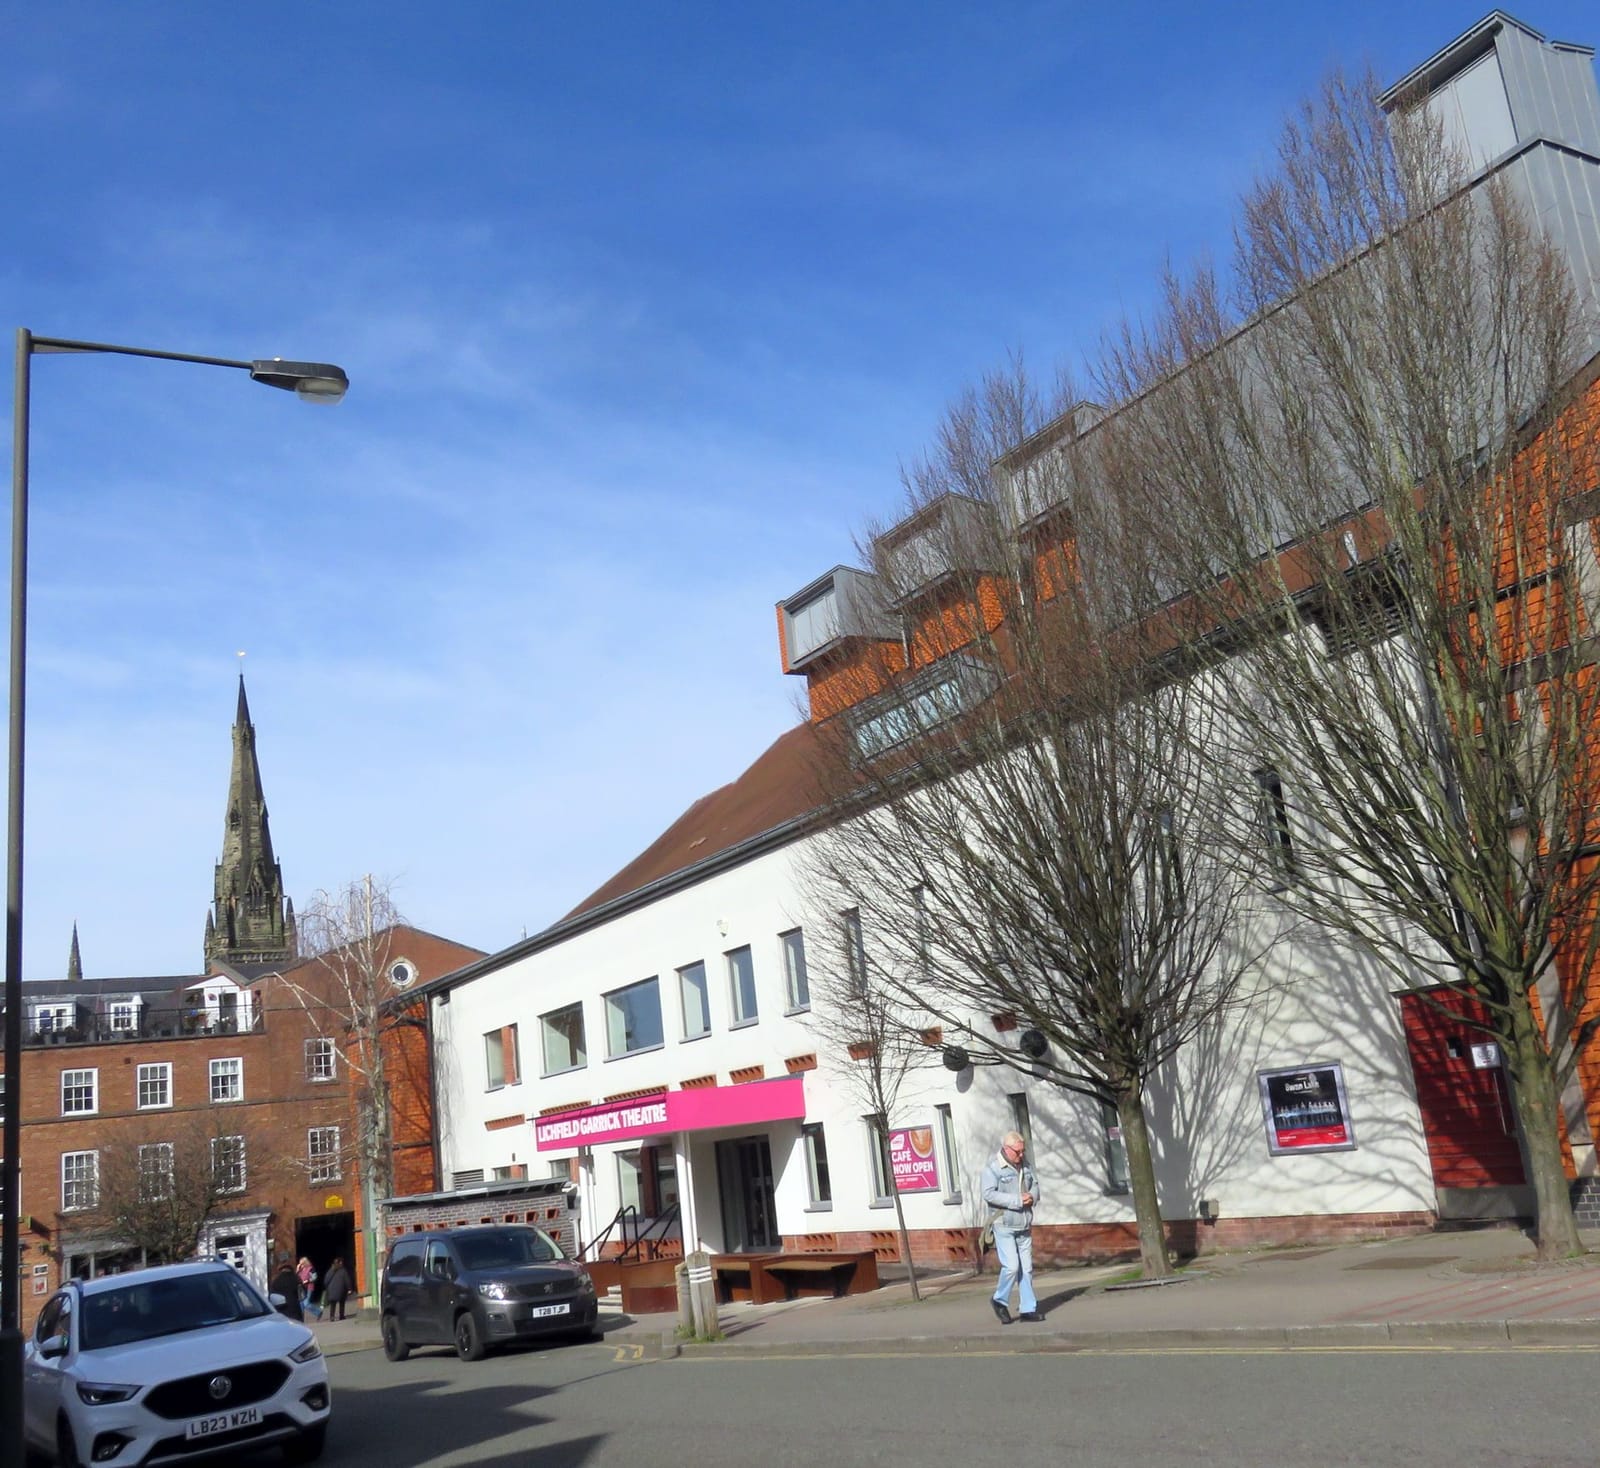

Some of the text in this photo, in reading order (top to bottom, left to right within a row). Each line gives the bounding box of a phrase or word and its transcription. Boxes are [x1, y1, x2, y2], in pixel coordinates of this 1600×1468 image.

[538, 1103, 667, 1142] LICHFIELD GARRICK THEATRE
[891, 1148, 912, 1162] CAFÉ
[893, 1161, 934, 1174] NOW OPEN
[191, 1408, 257, 1435] LB23 WZH
